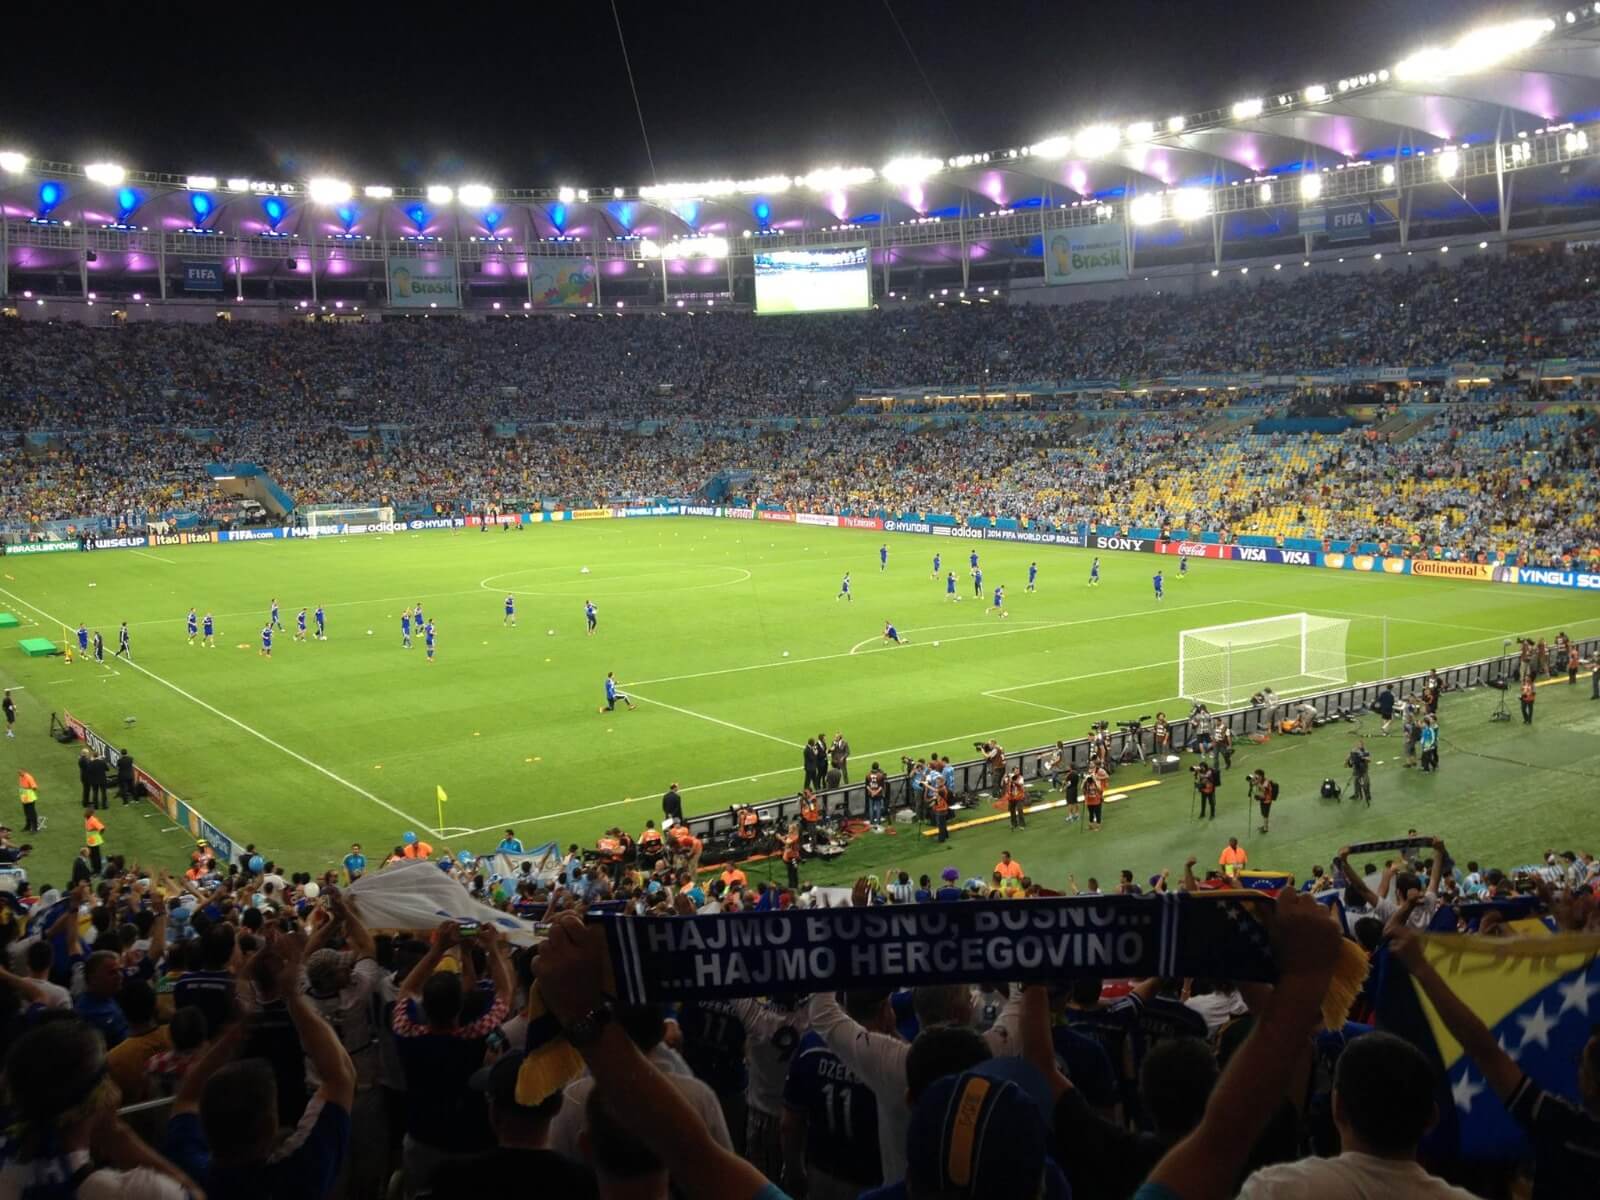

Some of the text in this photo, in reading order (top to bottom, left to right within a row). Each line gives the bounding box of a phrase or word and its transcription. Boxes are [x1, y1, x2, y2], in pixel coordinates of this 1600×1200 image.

[1334, 212, 1363, 227] FIFA
[188, 268, 216, 280] FIFA
[367, 521, 407, 534] adidas
[896, 522, 928, 533] HYUNDAI
[951, 527, 982, 539] adidas
[157, 534, 180, 545] Itaú
[187, 532, 210, 543] Itaú
[987, 530, 1001, 539] 2014
[1002, 531, 1015, 539] FIFA
[1017, 533, 1040, 542] WORLD
[1041, 534, 1055, 542] CUP
[1097, 536, 1144, 551] SONY
[1238, 547, 1267, 562] VISA
[1280, 550, 1311, 565] VISA
[1413, 559, 1478, 577] Continental
[1520, 569, 1574, 586] YINGLI
[647, 916, 792, 953] HAJMO
[851, 930, 1145, 976] HERCEGOVINO
[821, 1083, 854, 1140] 11
